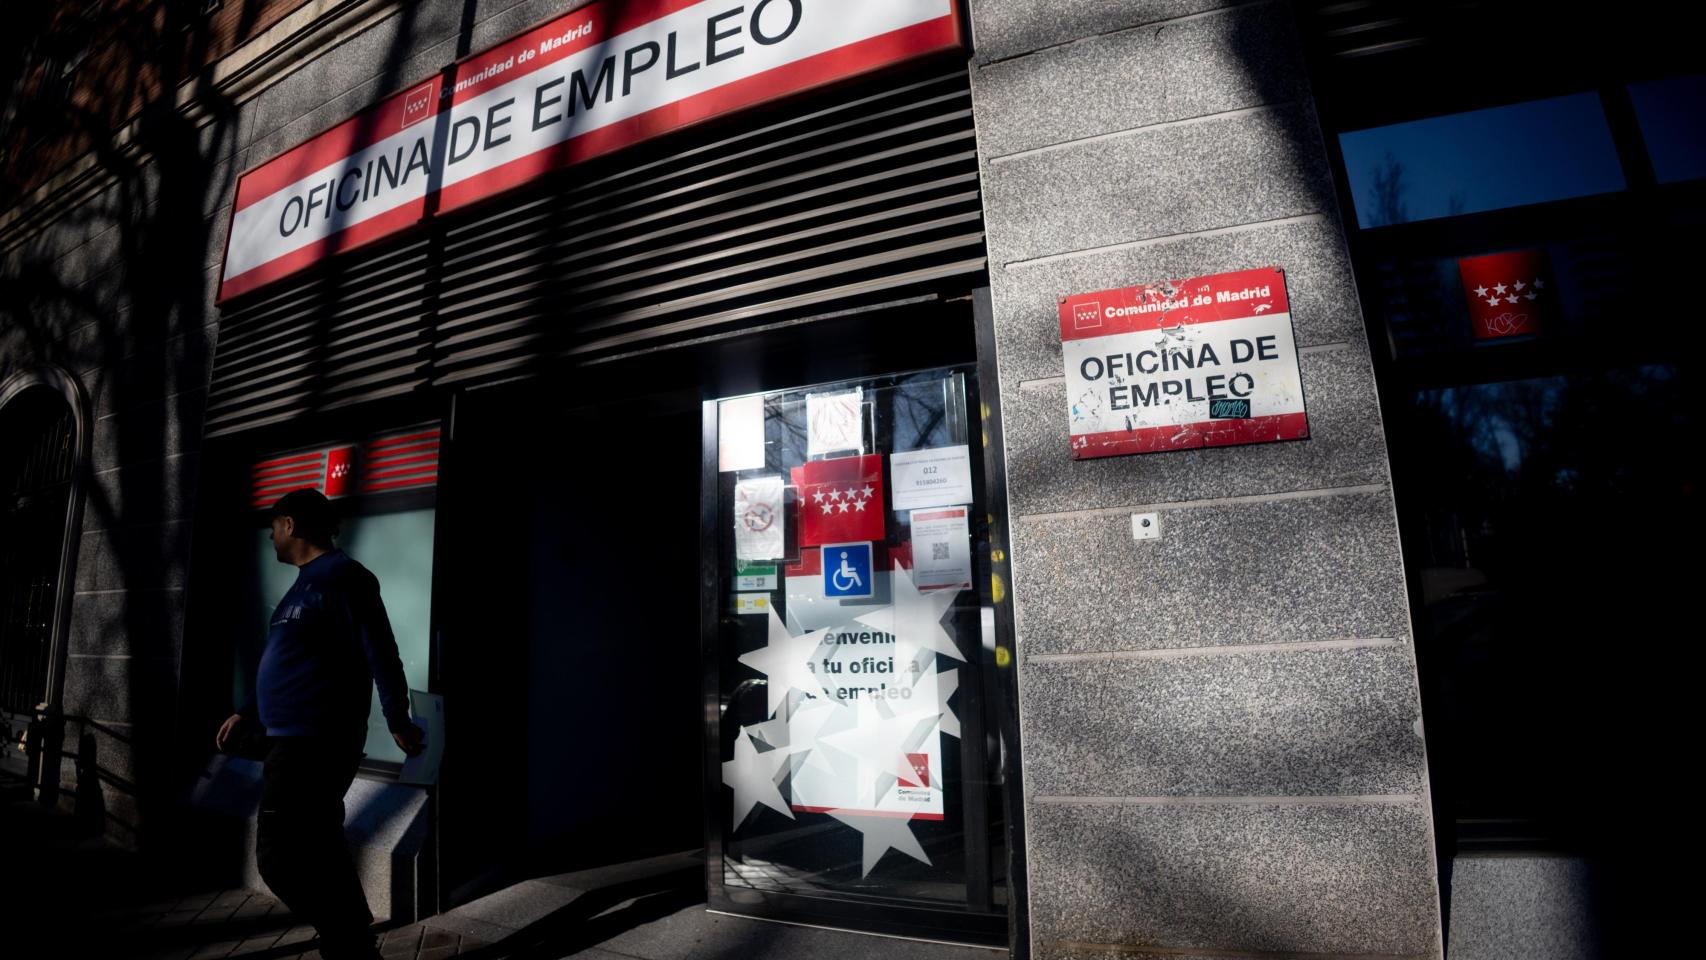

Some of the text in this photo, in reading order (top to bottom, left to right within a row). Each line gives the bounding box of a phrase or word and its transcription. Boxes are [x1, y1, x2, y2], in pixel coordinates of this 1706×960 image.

[439, 21, 593, 99] Comunidad de Madrid
[279, 0, 802, 239] OFICINA DE EMPLEO
[1105, 285, 1271, 319] Comunidad de Madrid
[1080, 335, 1279, 382] OFICINA DE
[1109, 373, 1255, 411] EMPLEO
[923, 466, 938, 475] 012
[823, 658, 842, 674] tu
[850, 657, 920, 674] oficia
